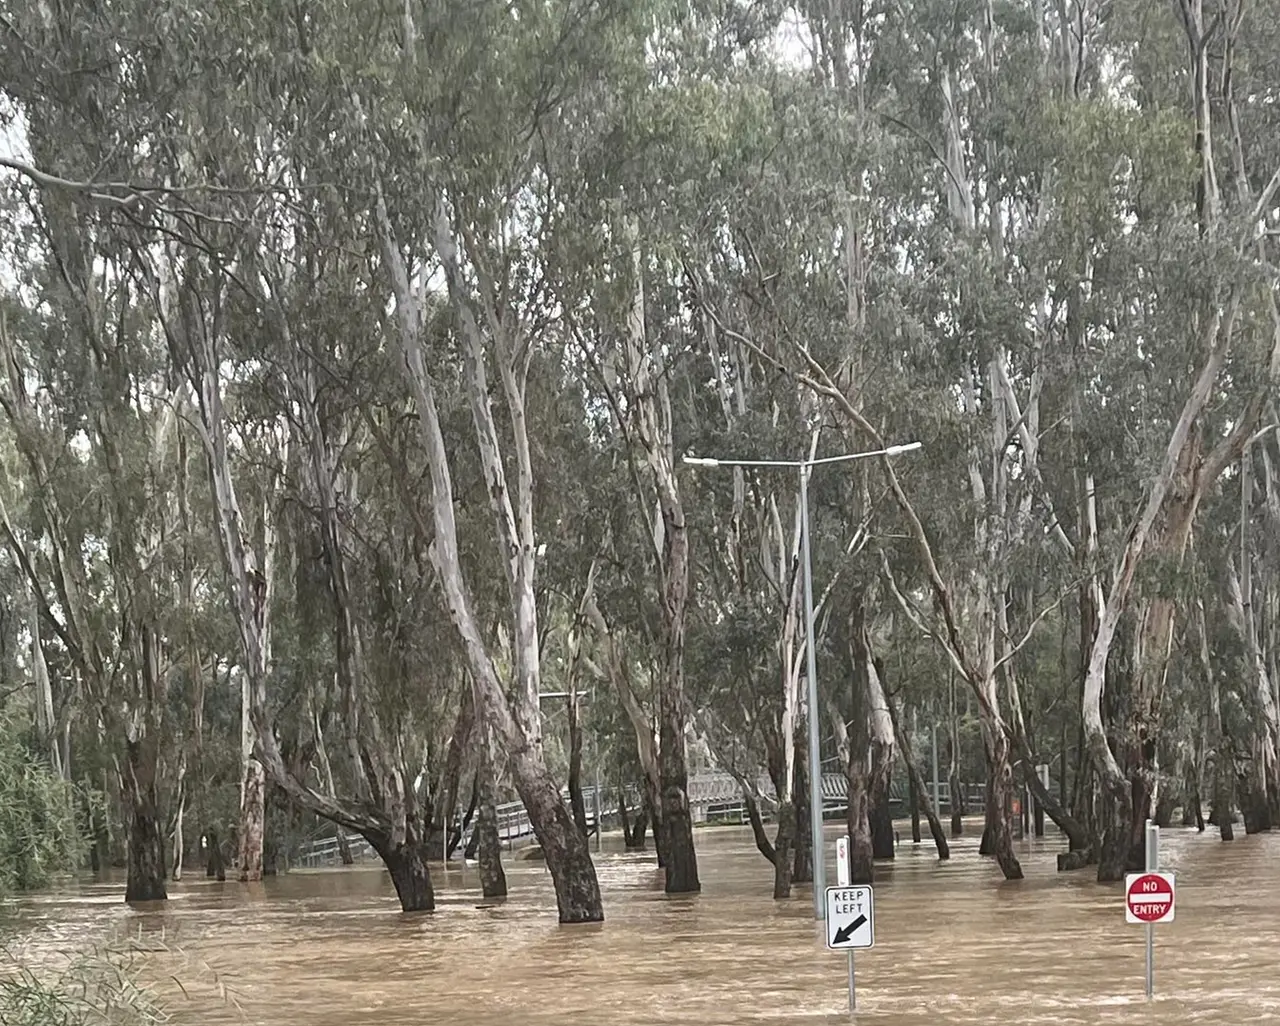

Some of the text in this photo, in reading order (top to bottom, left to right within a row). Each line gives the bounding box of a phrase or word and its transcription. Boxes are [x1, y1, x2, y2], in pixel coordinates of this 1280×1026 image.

[1142, 881, 1158, 892] NO
[834, 890, 864, 902] KEEP
[835, 903, 863, 914] LEFT
[1133, 904, 1167, 915] ENTRY
